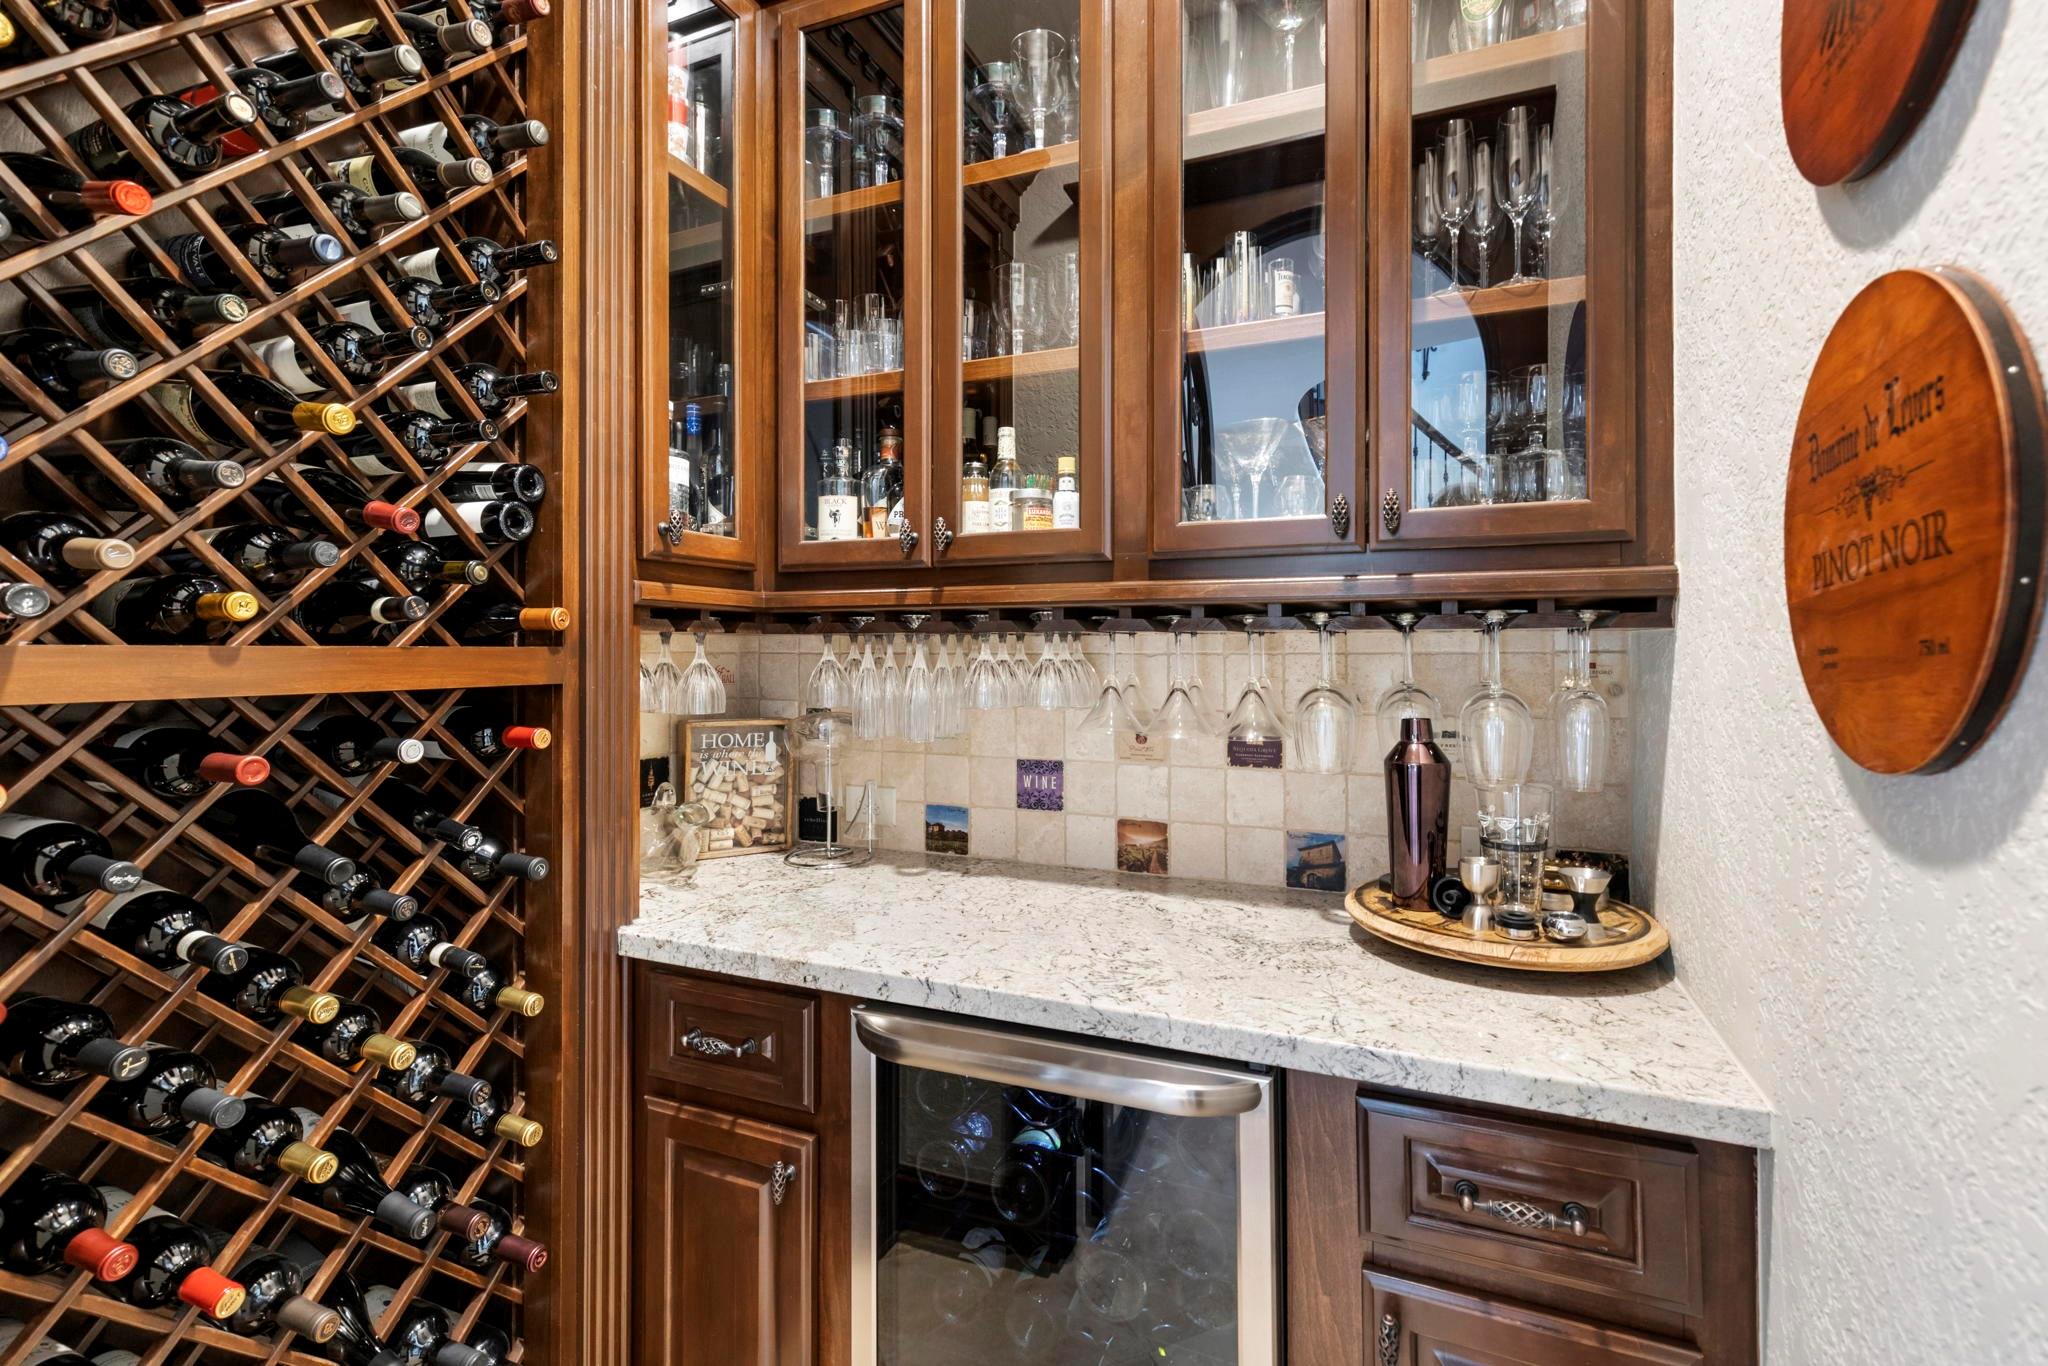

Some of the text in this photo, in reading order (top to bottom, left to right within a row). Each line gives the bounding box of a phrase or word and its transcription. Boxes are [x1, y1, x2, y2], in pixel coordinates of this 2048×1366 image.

[1812, 509, 1953, 591] PINOT NOIR
[701, 732, 765, 749] HOME
[700, 750, 709, 759] is
[701, 760, 764, 777] WINE
[1023, 774, 1057, 790] WINE
